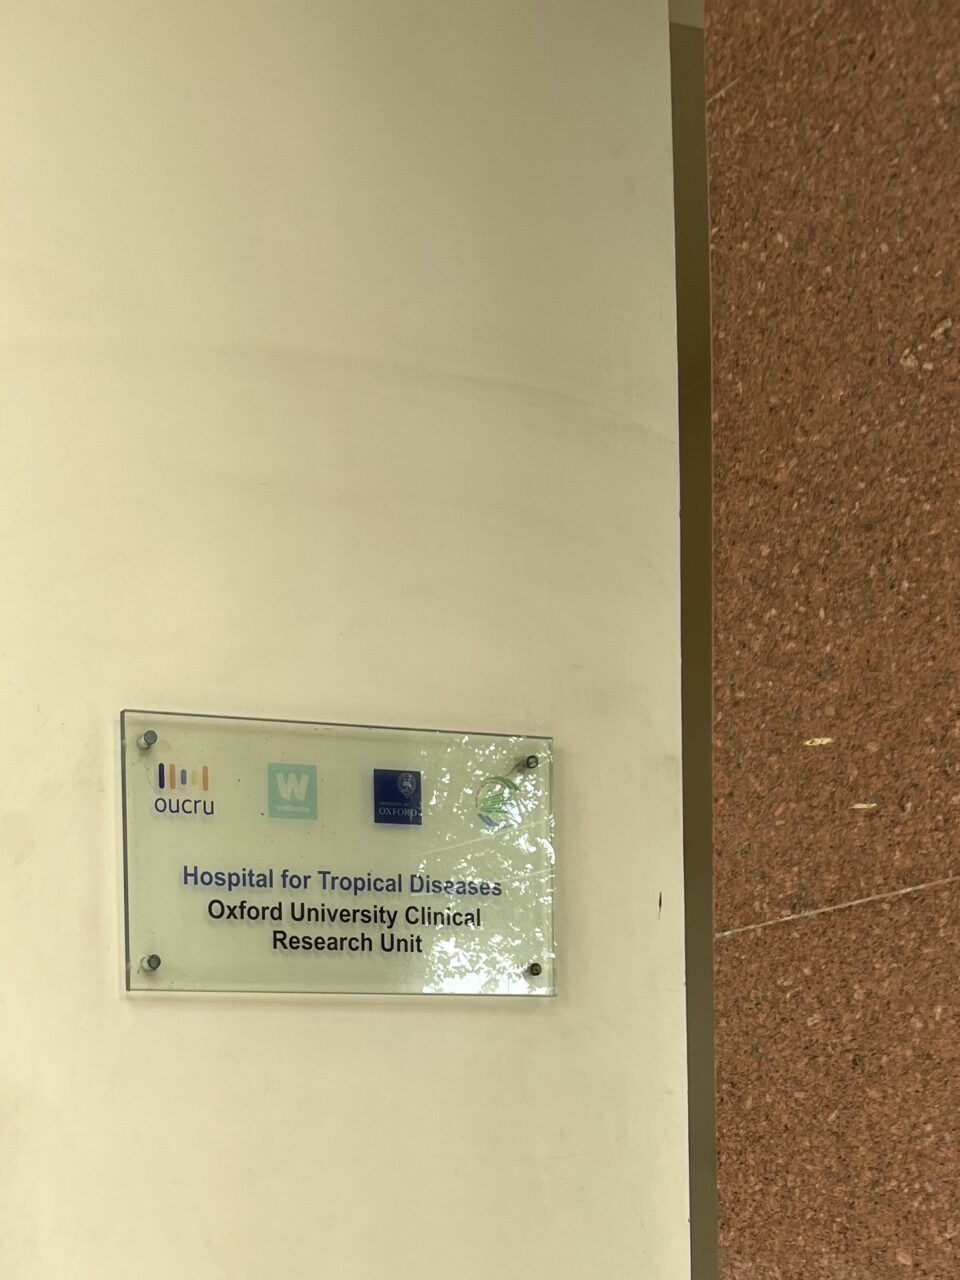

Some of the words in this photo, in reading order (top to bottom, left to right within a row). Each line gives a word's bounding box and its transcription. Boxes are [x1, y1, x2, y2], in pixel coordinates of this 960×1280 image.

[275, 771, 310, 801] W
[154, 797, 214, 816] oucru
[378, 806, 418, 817] OXFORD
[183, 865, 274, 891] Hospital
[280, 869, 312, 889] for
[317, 870, 402, 896] Tropical
[410, 874, 502, 896] Diseases
[208, 899, 283, 921] Oxford
[291, 902, 398, 929] University
[405, 905, 481, 927] Clinical
[272, 930, 373, 951] Research
[381, 933, 423, 953] Unit
